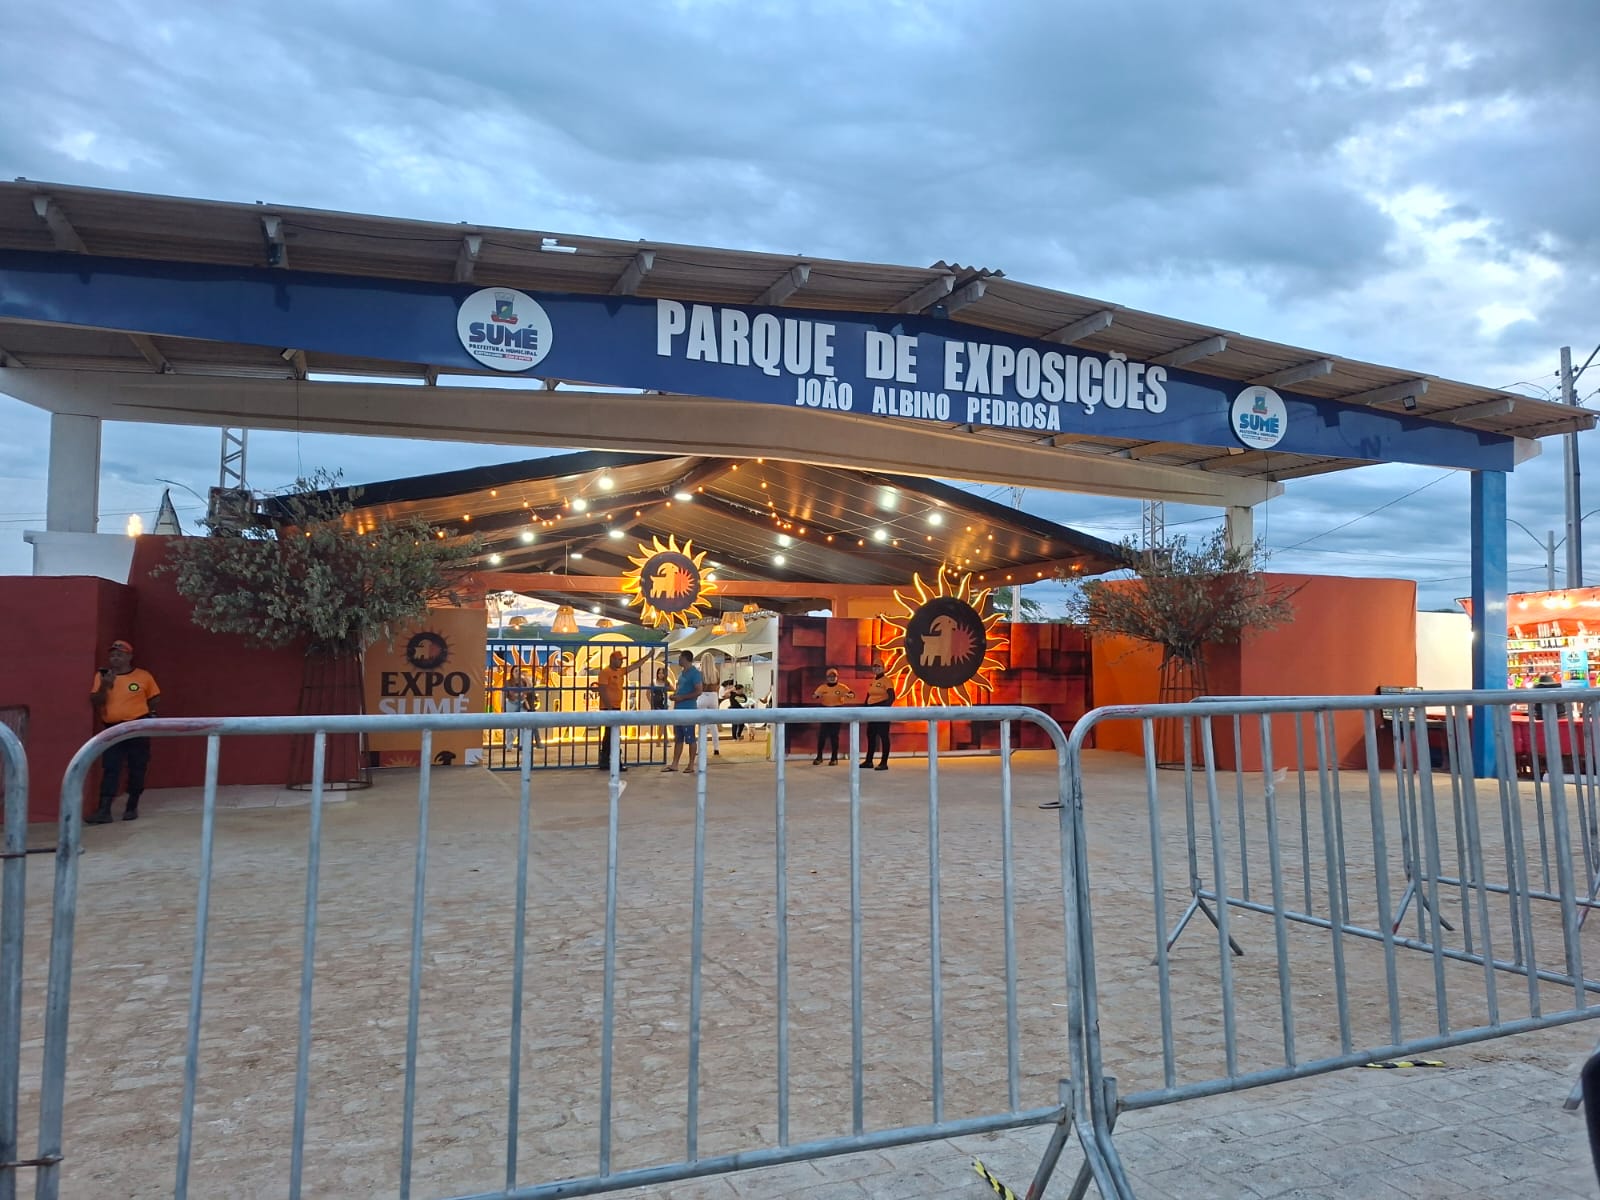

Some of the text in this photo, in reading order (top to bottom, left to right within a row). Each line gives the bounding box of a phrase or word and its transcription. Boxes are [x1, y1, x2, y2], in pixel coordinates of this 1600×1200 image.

[469, 322, 538, 350] SUMÉ
[657, 299, 1168, 415] PARQUE DE EXPOSIÇÕES
[796, 377, 1061, 431] JOÃO ALBINO PEDROSA
[1239, 413, 1279, 434] SUMÉ
[381, 671, 471, 697] EXPO
